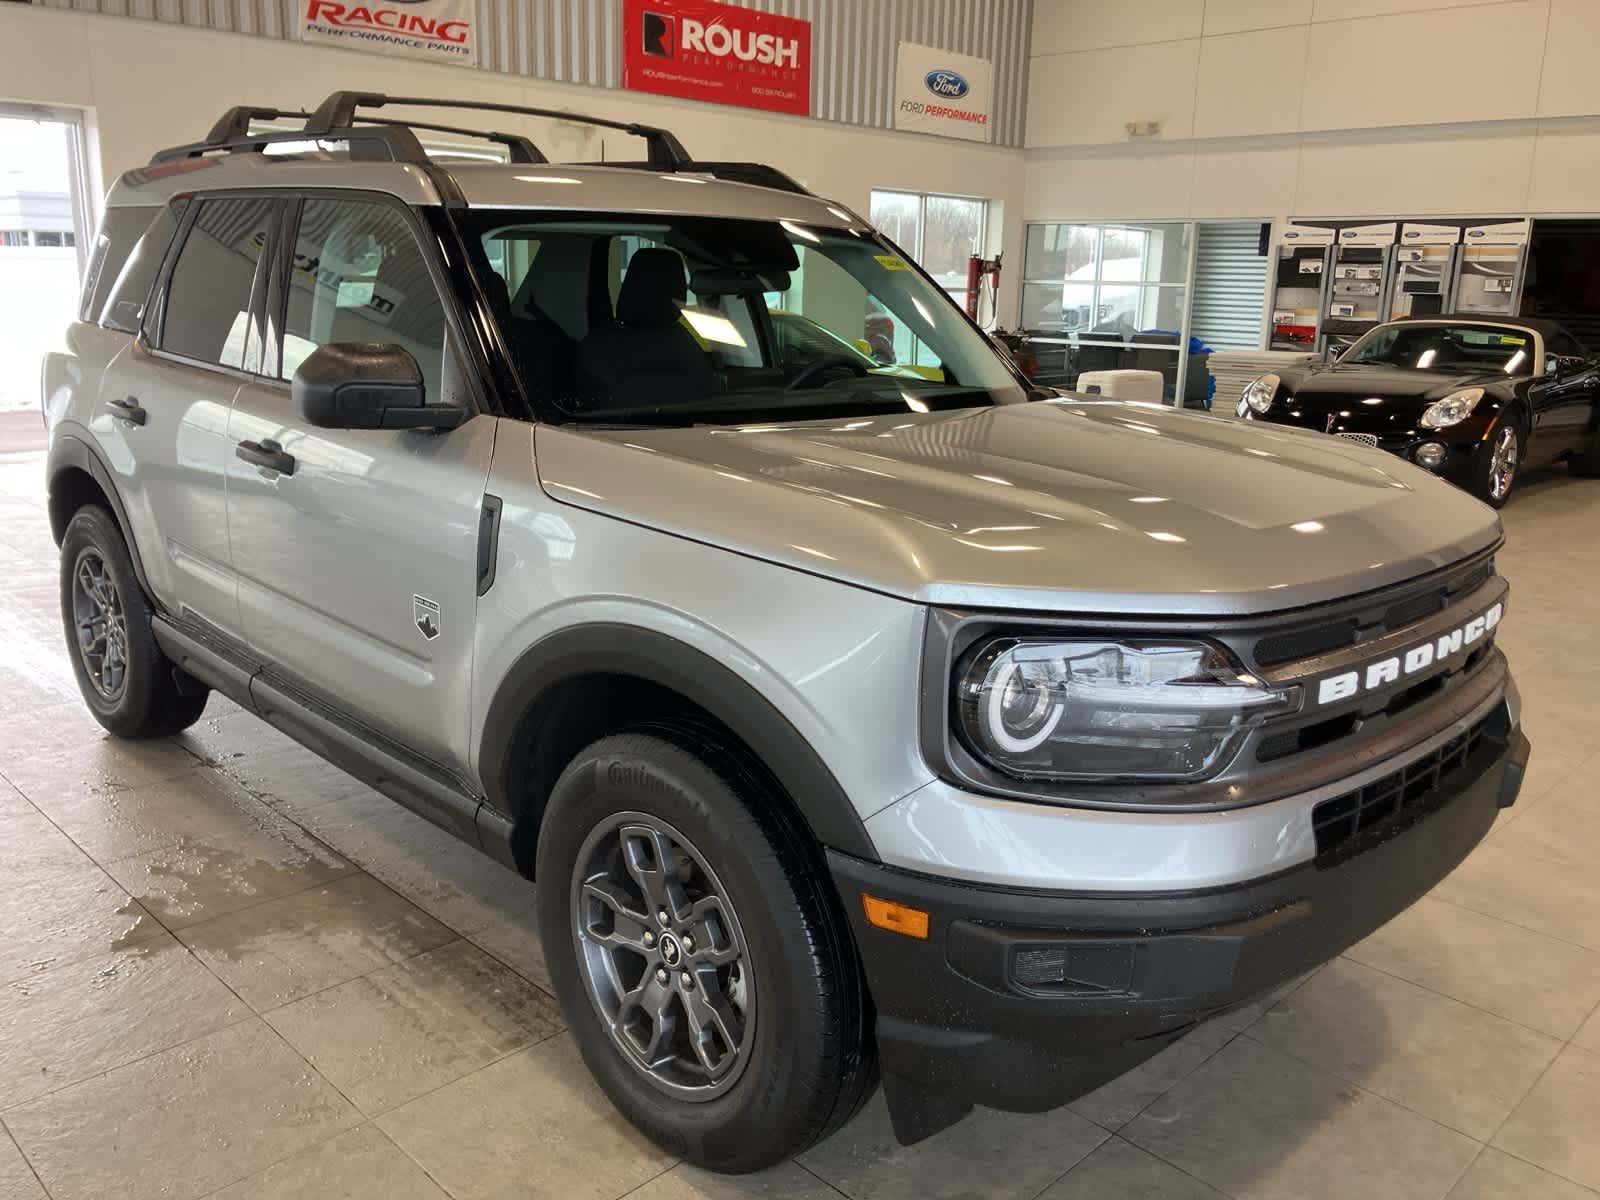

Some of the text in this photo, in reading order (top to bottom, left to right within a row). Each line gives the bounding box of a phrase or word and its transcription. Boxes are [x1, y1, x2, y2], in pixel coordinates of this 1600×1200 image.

[306, 0, 469, 43] RACING
[307, 24, 470, 54] PERFORMANCE PARTS
[681, 18, 798, 69] ROUSH
[682, 53, 797, 81] PERFORMANCE
[933, 73, 961, 95] Ford
[900, 100, 988, 125] FORD PERFORMANCE
[1318, 602, 1503, 705] BRONCO
